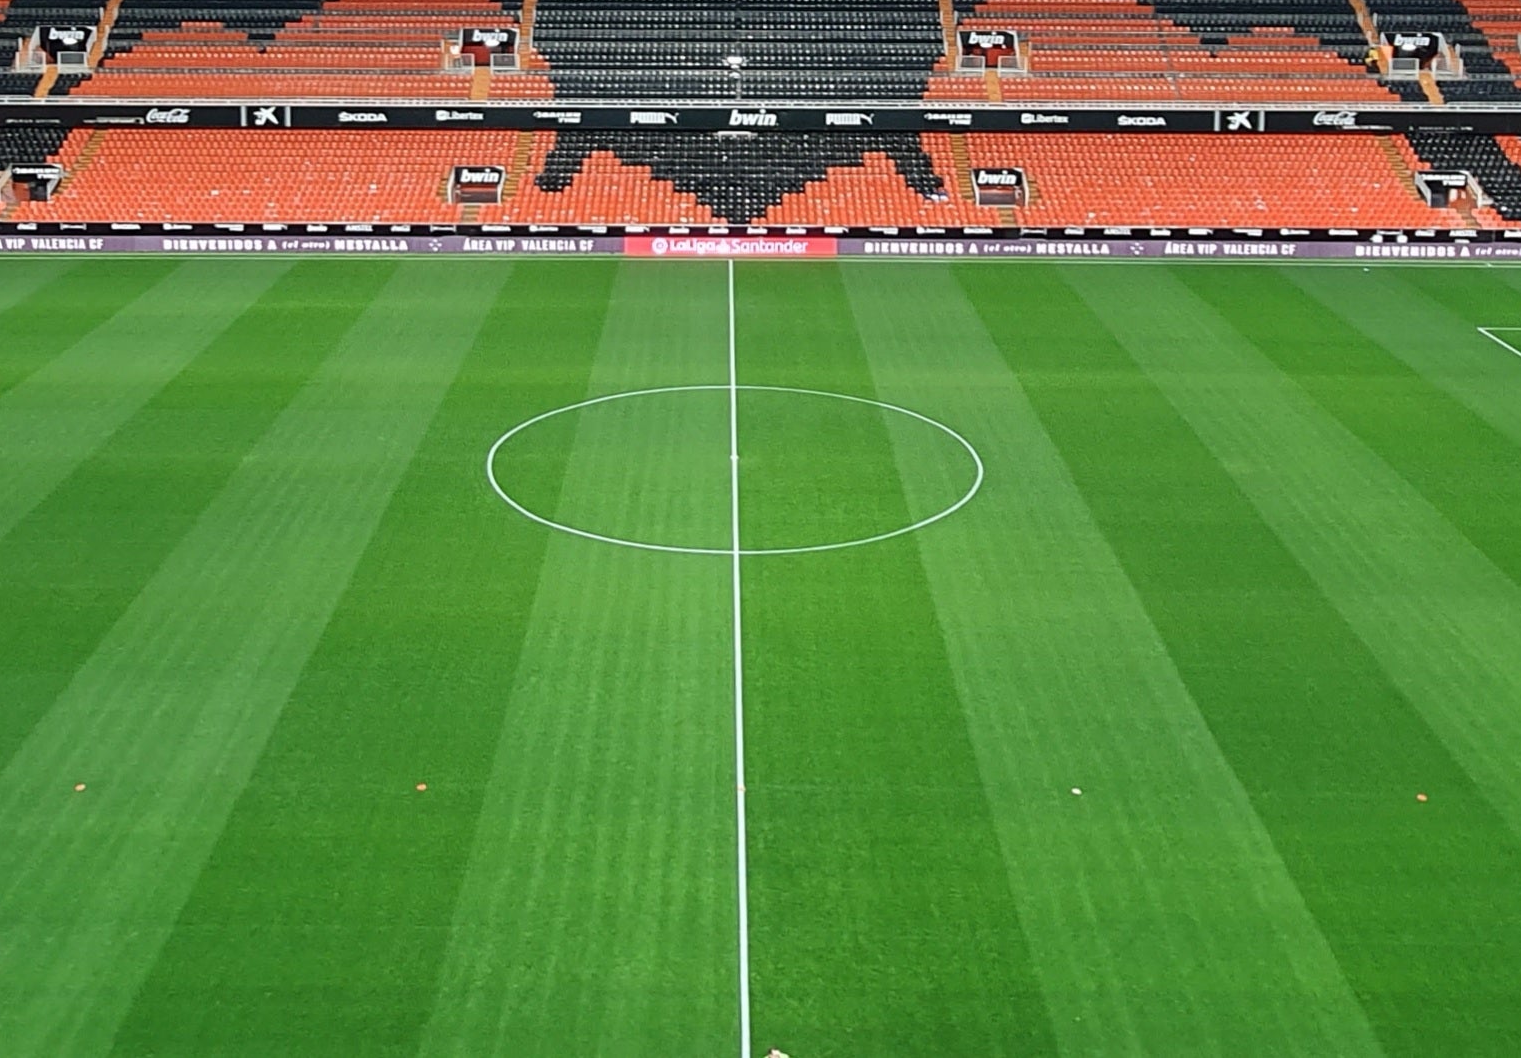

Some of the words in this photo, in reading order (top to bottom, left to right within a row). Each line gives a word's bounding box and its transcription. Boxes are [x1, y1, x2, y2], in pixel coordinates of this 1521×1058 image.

[472, 29, 508, 43] bwin
[969, 32, 1005, 45] bwin
[729, 109, 779, 126] bwin
[459, 168, 501, 184] bwin
[978, 170, 1018, 186] bwin
[4, 239, 26, 250] VIP
[30, 239, 86, 250] VALENCIA
[163, 239, 263, 251] BIENVENIDOS
[266, 239, 278, 251] A
[281, 239, 299, 251] (el
[301, 239, 331, 251] otro)
[334, 239, 409, 251] MESTALLA
[462, 237, 493, 251] ÁREA
[495, 240, 516, 252] VIP
[521, 240, 577, 252] VALENCIA
[579, 240, 595, 252] CF
[669, 239, 716, 255] LaLiga
[730, 239, 809, 254] Santander
[864, 242, 965, 254] BIENVENIDOS
[968, 242, 979, 254] A
[1035, 243, 1111, 255] MESTALLA
[1164, 240, 1195, 254] ÁREA
[1197, 243, 1218, 255] VIP
[1222, 243, 1278, 255] VALENCIA
[1280, 243, 1297, 255] CF
[1355, 245, 1457, 257] BIENVENIDOS
[1460, 245, 1471, 257] A
